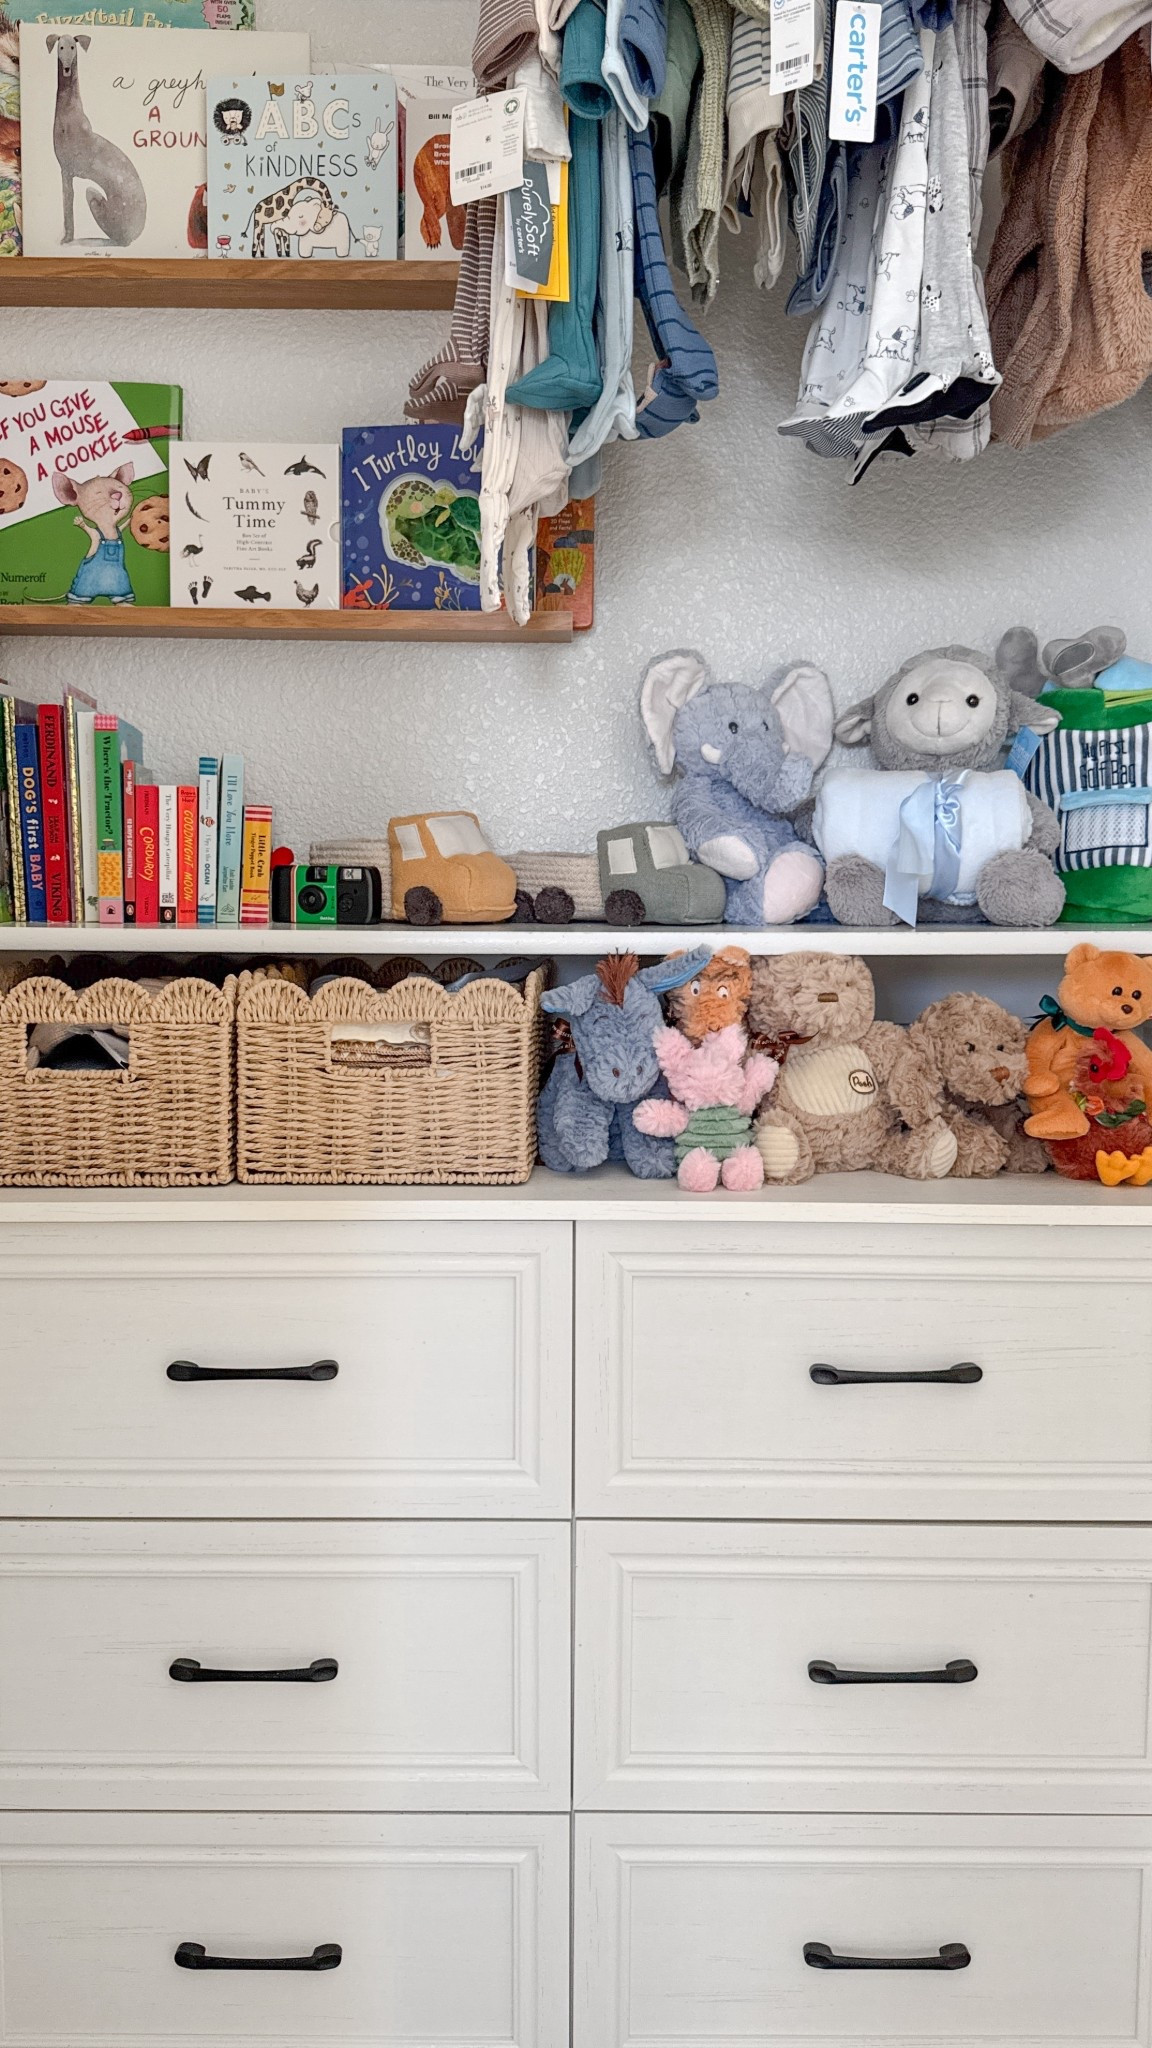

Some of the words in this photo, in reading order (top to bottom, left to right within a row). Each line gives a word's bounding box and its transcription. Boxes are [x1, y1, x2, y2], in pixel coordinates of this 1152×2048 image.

[217, 5, 229, 13] 50
[845, 13, 868, 123] carter's
[112, 76, 135, 90] a
[142, 68, 207, 109] greyh
[424, 76, 444, 87] The
[447, 76, 469, 91] Very
[148, 105, 161, 123] A
[254, 98, 361, 141] ABCs
[133, 129, 207, 149] GROUN
[265, 141, 278, 153] of
[515, 218, 522, 226] by
[516, 227, 525, 254] carter's
[0, 416, 9, 440] F
[12, 403, 46, 432] YOU
[50, 388, 96, 419] GIVE
[30, 436, 40, 456] A
[44, 412, 109, 448] MOUSE
[37, 462, 48, 482] A
[55, 431, 122, 472] COOKIE
[352, 466, 371, 492] I
[363, 434, 443, 481] Turtley
[222, 496, 286, 516] Tummy
[233, 514, 276, 528] Time
[1, 572, 47, 583] Numeroff
[45, 715, 57, 788] FERDINAND
[103, 736, 112, 774] Where's
[1099, 738, 1128, 757] First
[22, 767, 37, 814] DOG'S
[104, 776, 112, 791] the
[164, 794, 172, 805] The
[227, 789, 238, 806] Love
[104, 793, 114, 835] Tractor?
[164, 807, 172, 822] Very
[225, 809, 238, 823] You
[27, 819, 39, 849] first
[126, 839, 133, 847] OF
[164, 824, 172, 844] Hungry
[183, 809, 194, 869] GOODNIGHT
[138, 827, 155, 882] CORDUROY
[258, 835, 267, 857] Little
[30, 854, 43, 891] BABY
[164, 848, 172, 881] Caterpillar
[257, 859, 265, 878] Crab
[51, 872, 62, 917] VIKING
[183, 871, 194, 902] MOON
[851, 1075, 874, 1088] Pooh
